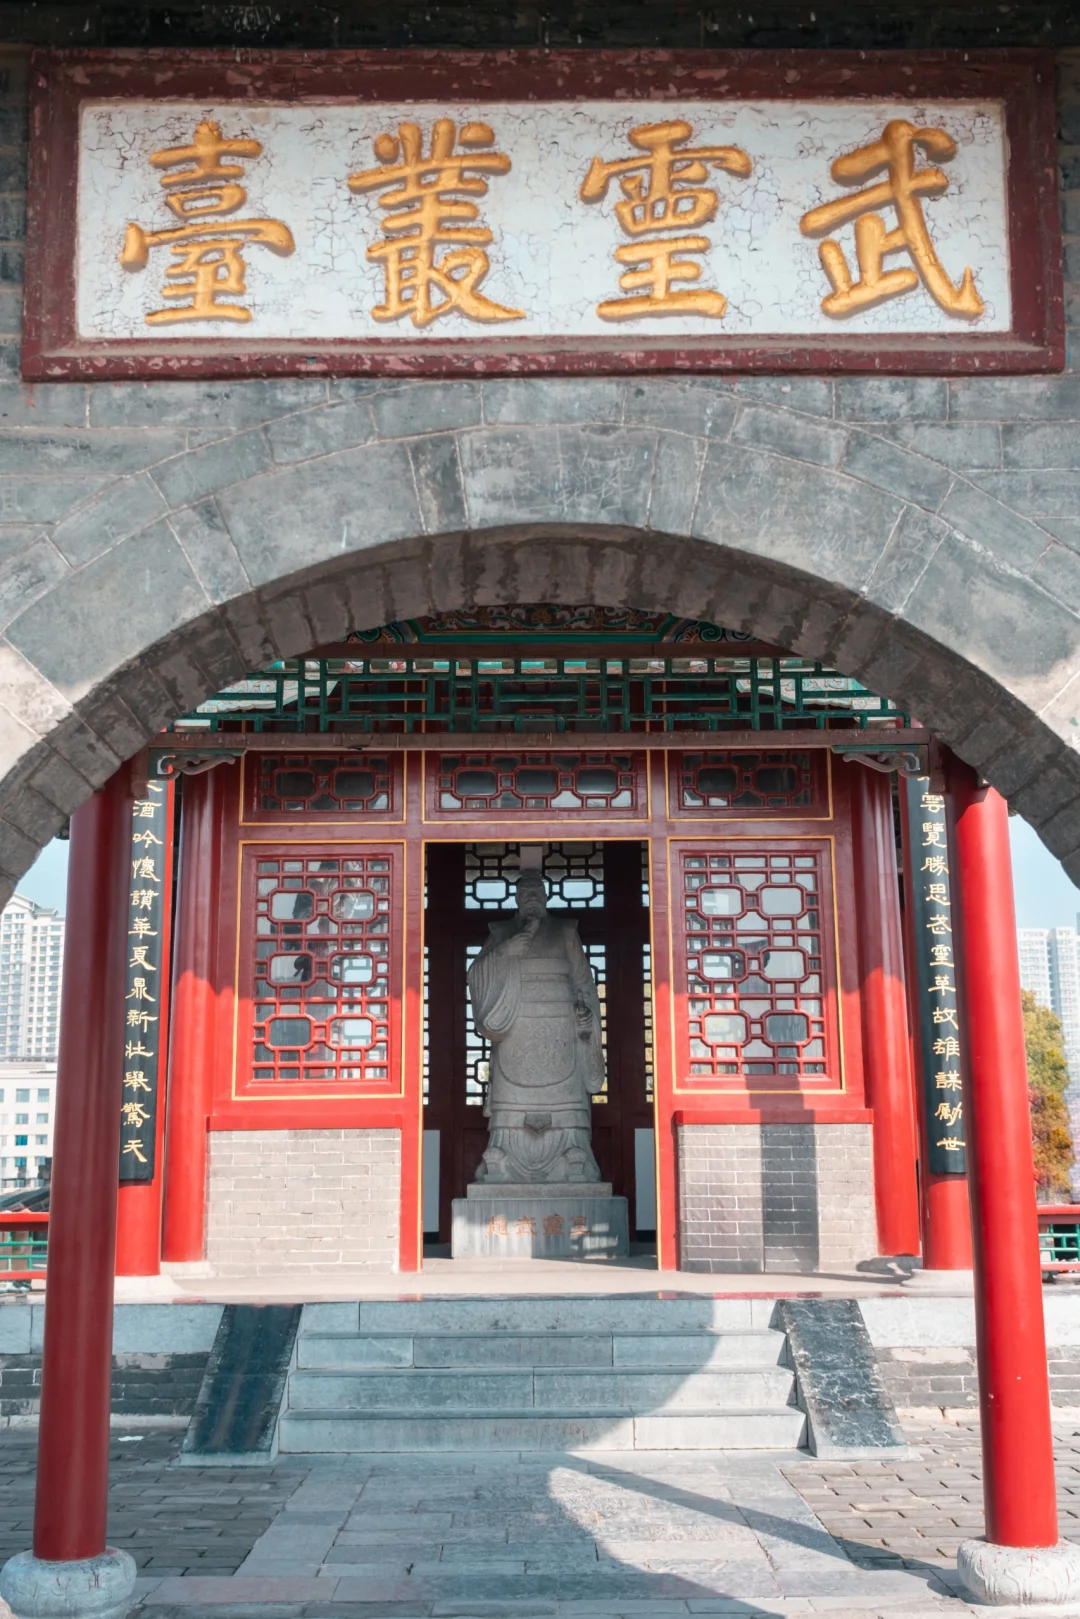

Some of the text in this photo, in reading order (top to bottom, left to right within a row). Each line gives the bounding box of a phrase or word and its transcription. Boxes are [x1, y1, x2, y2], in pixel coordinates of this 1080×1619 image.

[917, 776, 966, 1151] 雲覽勝思武靈革故雄謀勵世
